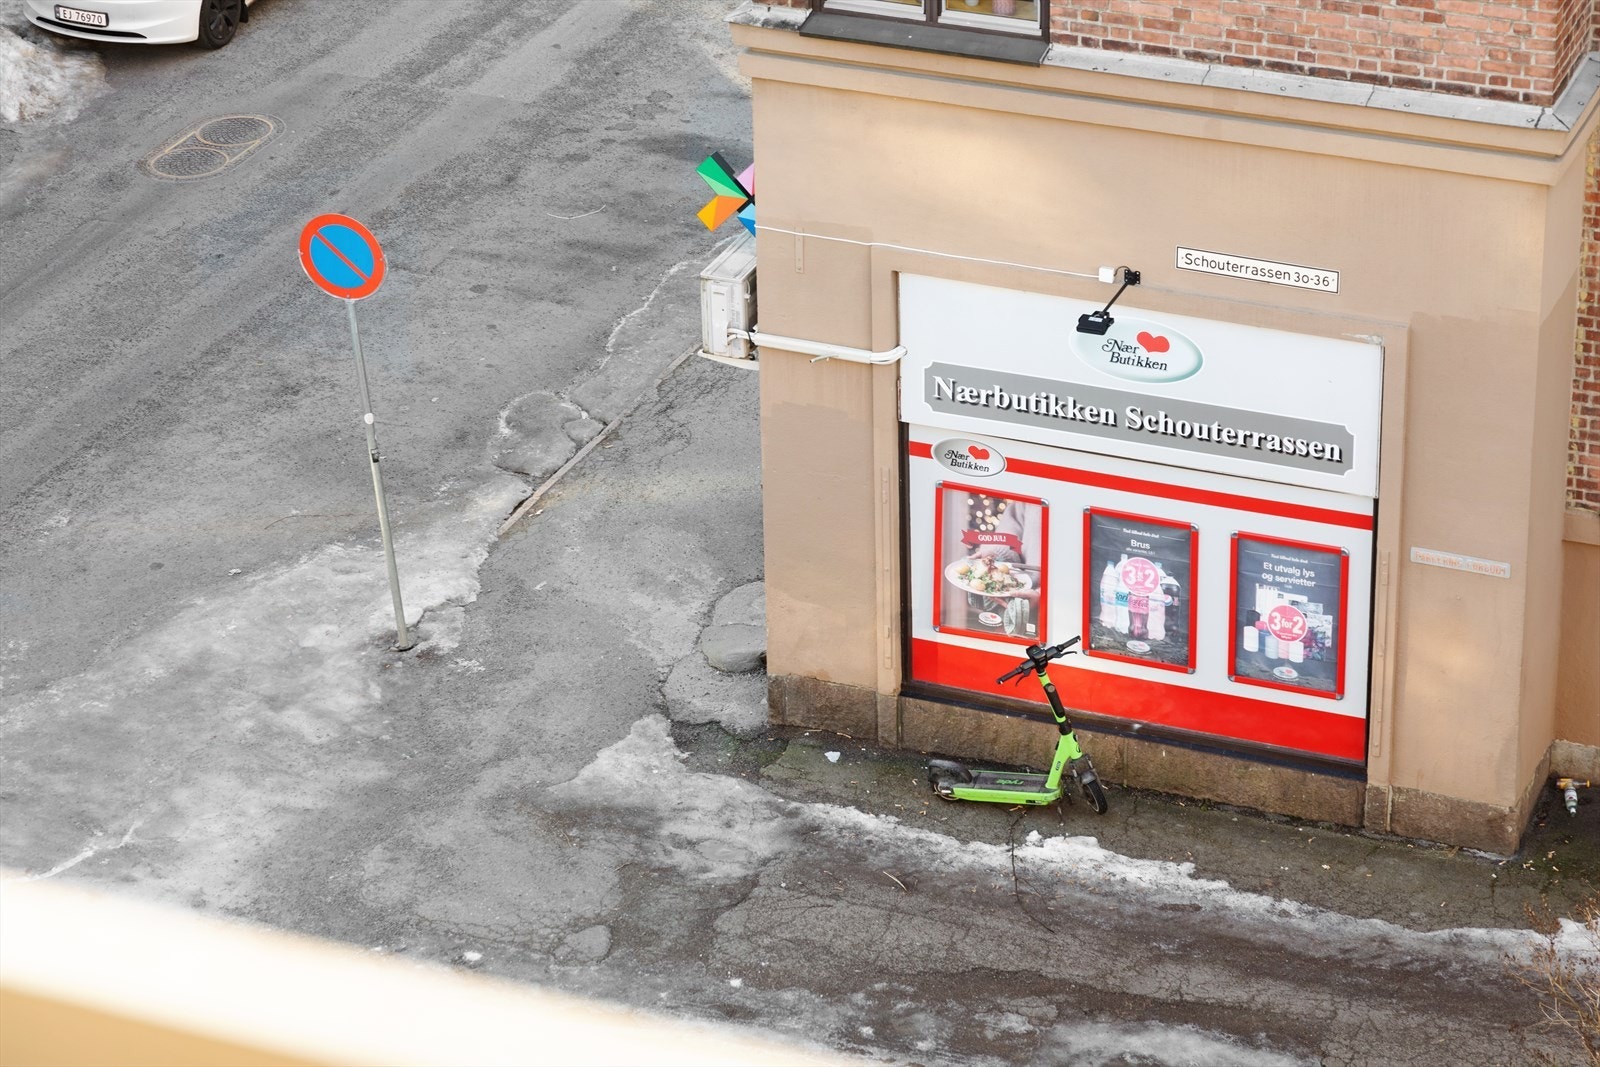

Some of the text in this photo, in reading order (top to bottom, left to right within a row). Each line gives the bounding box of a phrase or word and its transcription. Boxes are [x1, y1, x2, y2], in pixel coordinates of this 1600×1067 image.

[63, 9, 103, 24] EJ 76970
[1184, 252, 1330, 287] Schouterrassen 30-36
[1101, 338, 1140, 354] Nær
[1109, 351, 1168, 371] Butikken
[932, 375, 1343, 463] Nærbutikken Schouterrassen
[944, 449, 970, 460] Nær
[950, 458, 990, 472] Butikken
[977, 534, 992, 542] GOD
[1130, 539, 1151, 550] Brus
[1124, 566, 1136, 585] 3
[1144, 569, 1155, 588] 2
[1263, 562, 1316, 578] Et utvalg lys
[1261, 572, 1273, 582] og
[1275, 575, 1317, 587] servietter
[1270, 612, 1304, 634] 3 for 2
